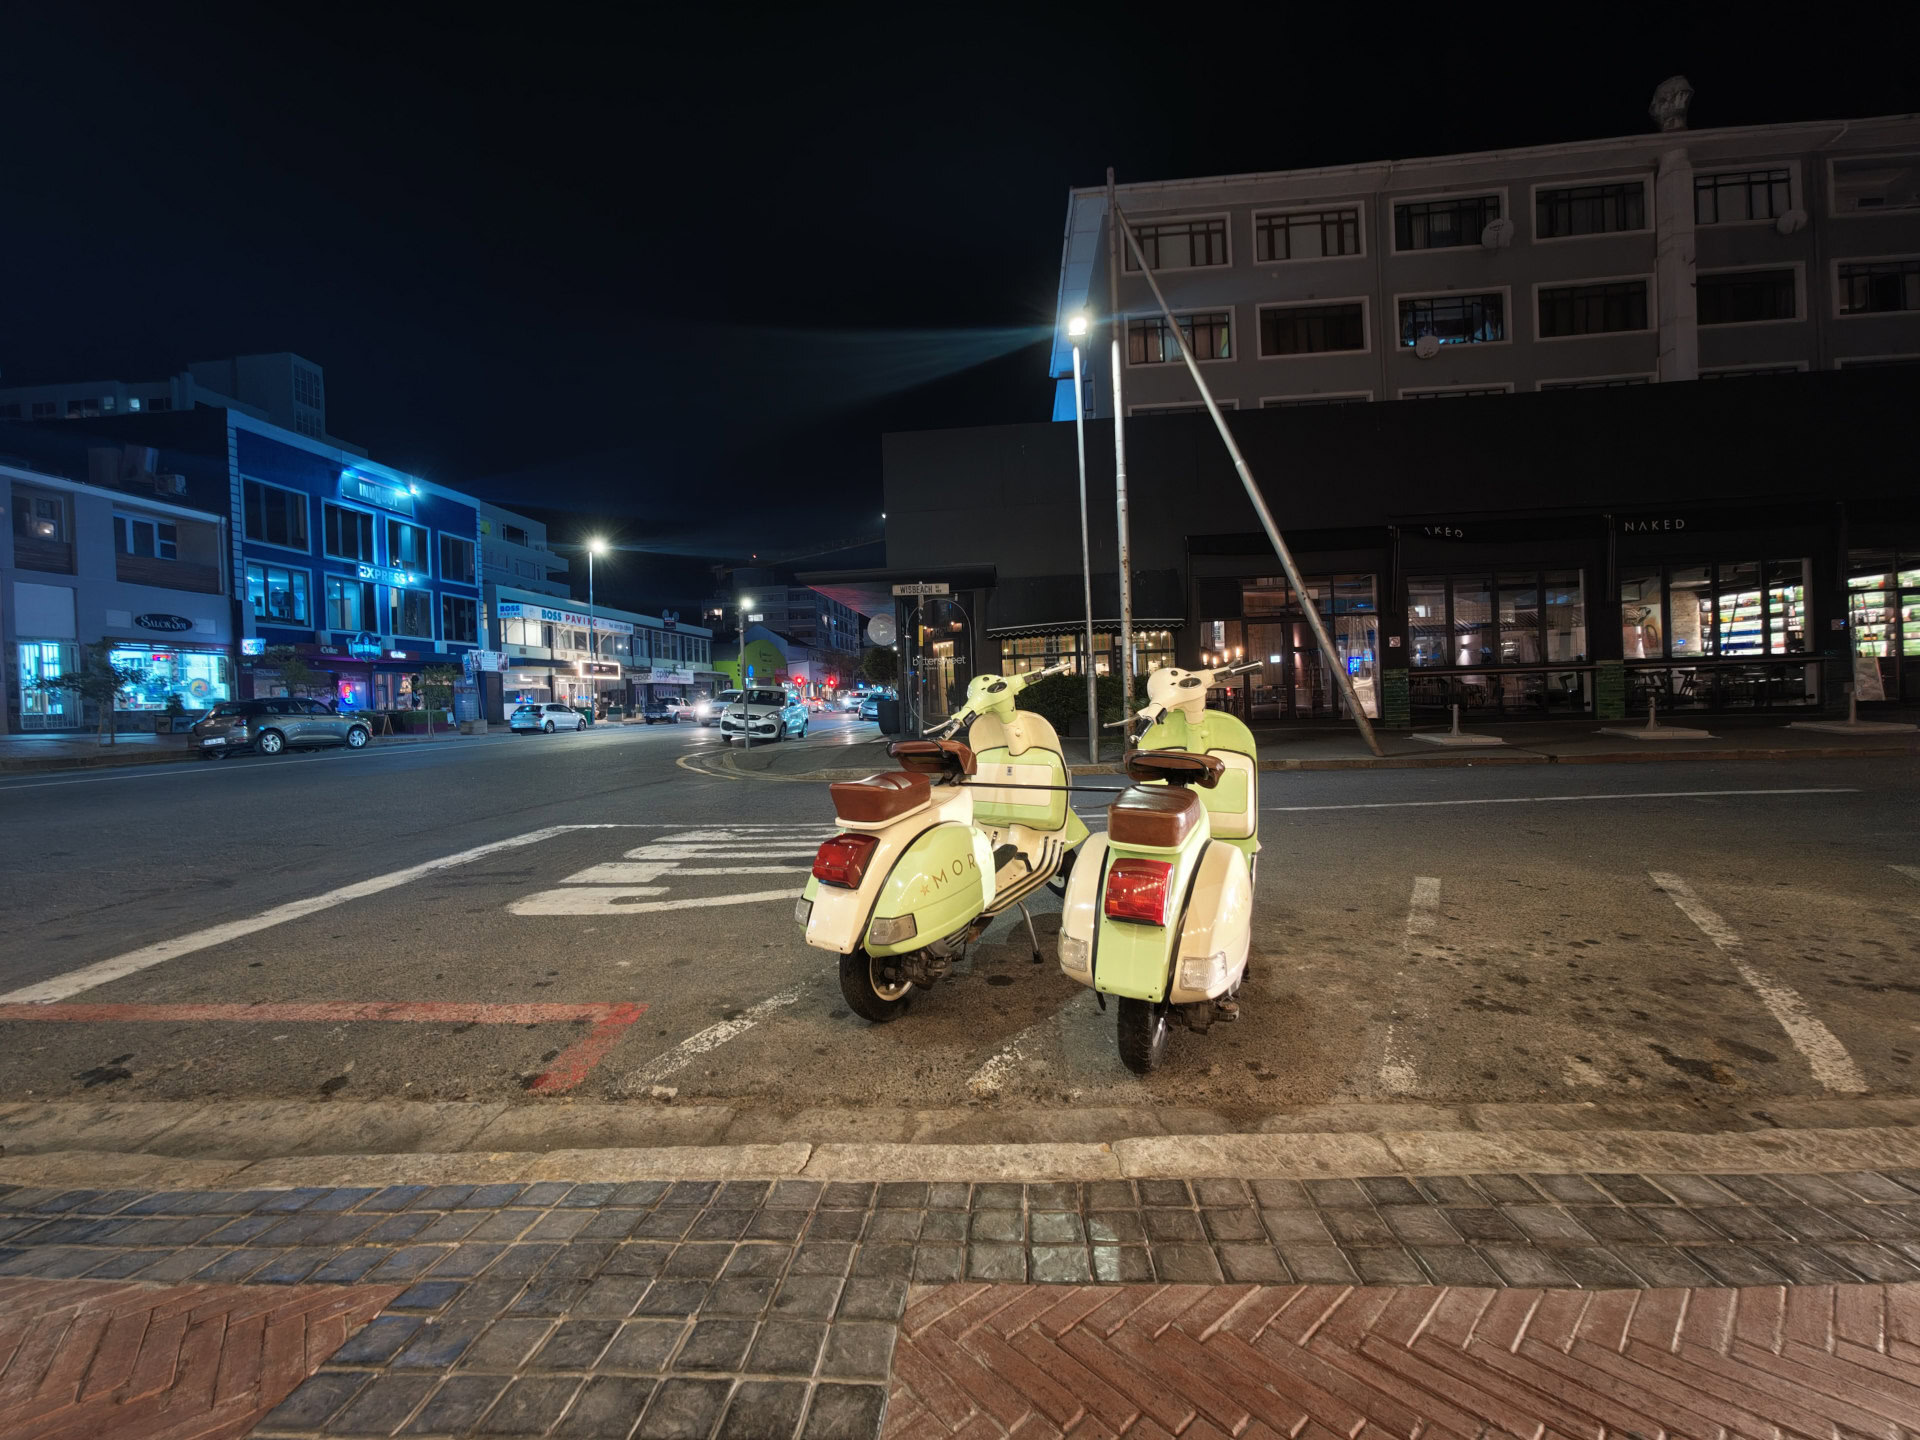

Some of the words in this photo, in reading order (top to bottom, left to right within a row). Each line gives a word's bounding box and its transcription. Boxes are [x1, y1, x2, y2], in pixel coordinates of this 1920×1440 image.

[1624, 518, 1686, 533] NAKED
[900, 585, 933, 595] WISBEACH
[541, 609, 562, 621] BOSS
